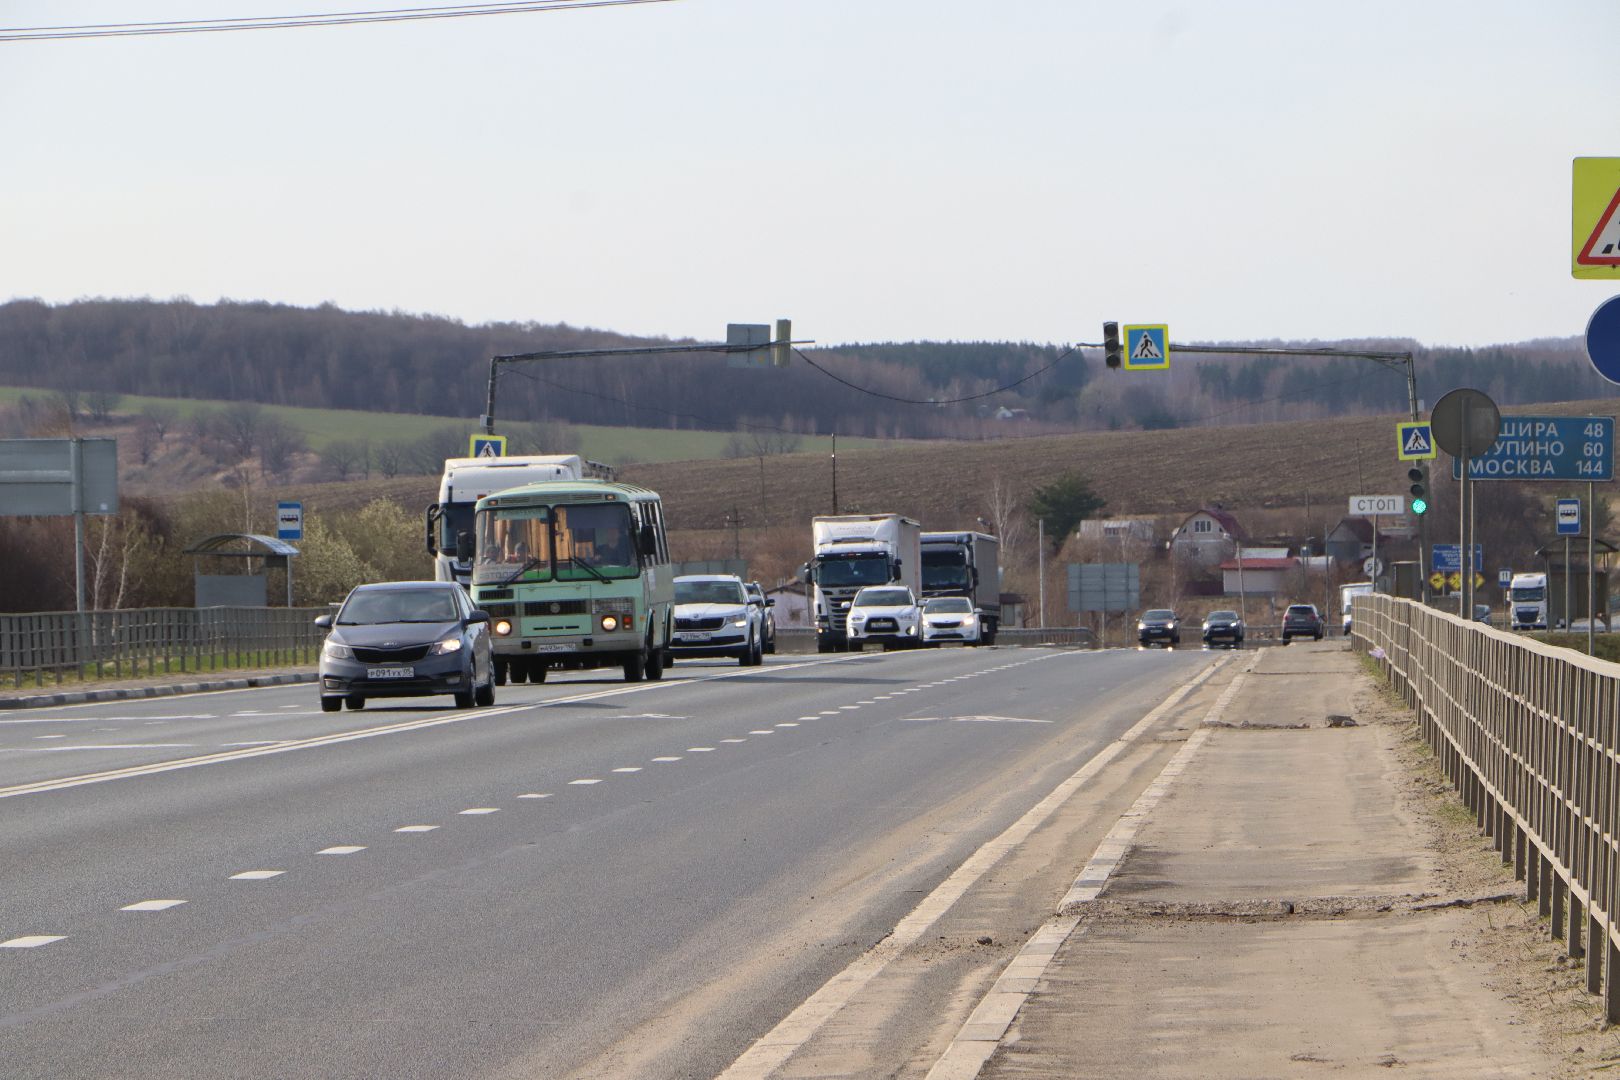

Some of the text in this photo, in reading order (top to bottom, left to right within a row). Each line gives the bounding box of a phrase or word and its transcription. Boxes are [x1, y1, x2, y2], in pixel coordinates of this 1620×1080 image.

[1499, 422, 1604, 438] ШИРА 48
[1484, 441, 1604, 457] УПИНО 60
[1468, 459, 1603, 475] МОСКВА 144
[1357, 498, 1396, 511] СТОП
